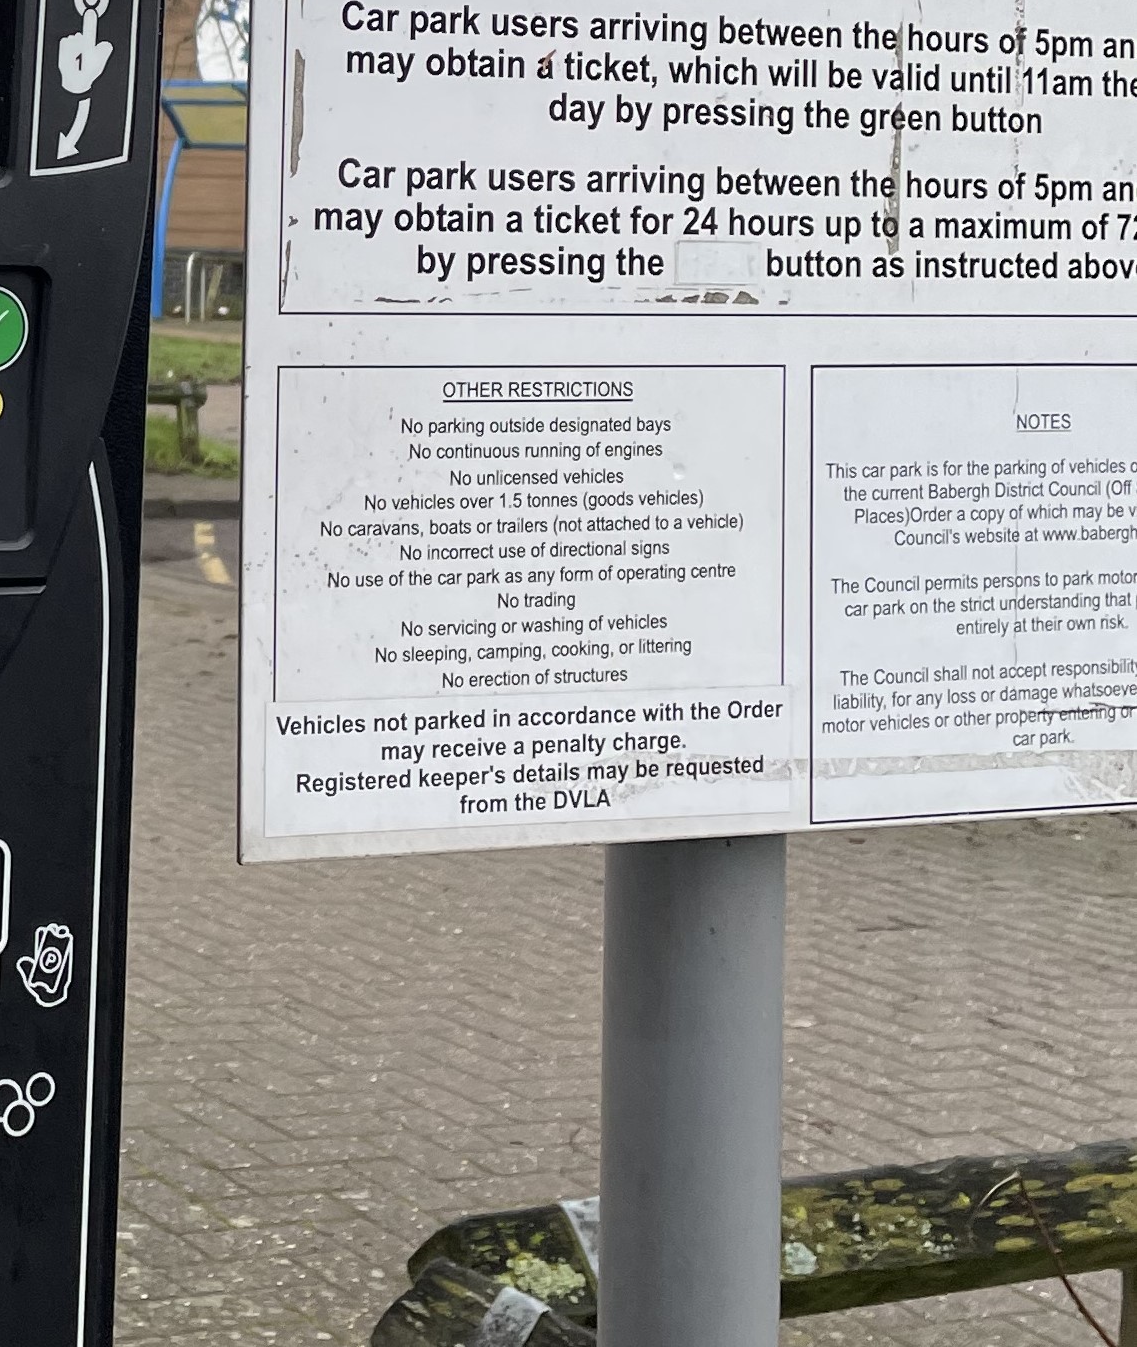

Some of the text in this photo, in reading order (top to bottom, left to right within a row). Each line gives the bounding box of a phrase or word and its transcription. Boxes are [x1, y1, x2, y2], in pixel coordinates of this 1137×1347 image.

[443, 381, 633, 399] OTHER RESTRICTIONS
[401, 416, 672, 438] No parking outside designated bays
[1016, 414, 1071, 430] NOTES
[450, 468, 624, 486] No unlicensed vehicles
[364, 489, 704, 513] No vehicles over 1.5 tonnes (goods vehicles)
[830, 578, 860, 595] The
[864, 575, 920, 594] Council
[924, 574, 979, 595] permits
[983, 575, 1041, 591] persons
[1044, 572, 1059, 587] to
[1062, 570, 1094, 590] park
[497, 591, 576, 611] No trading
[956, 613, 1130, 638] entirely at their own risk.
[442, 667, 628, 689] No erection of structures
[381, 731, 686, 765] may receive a penalty charge.
[459, 788, 611, 814] from the DVLA
